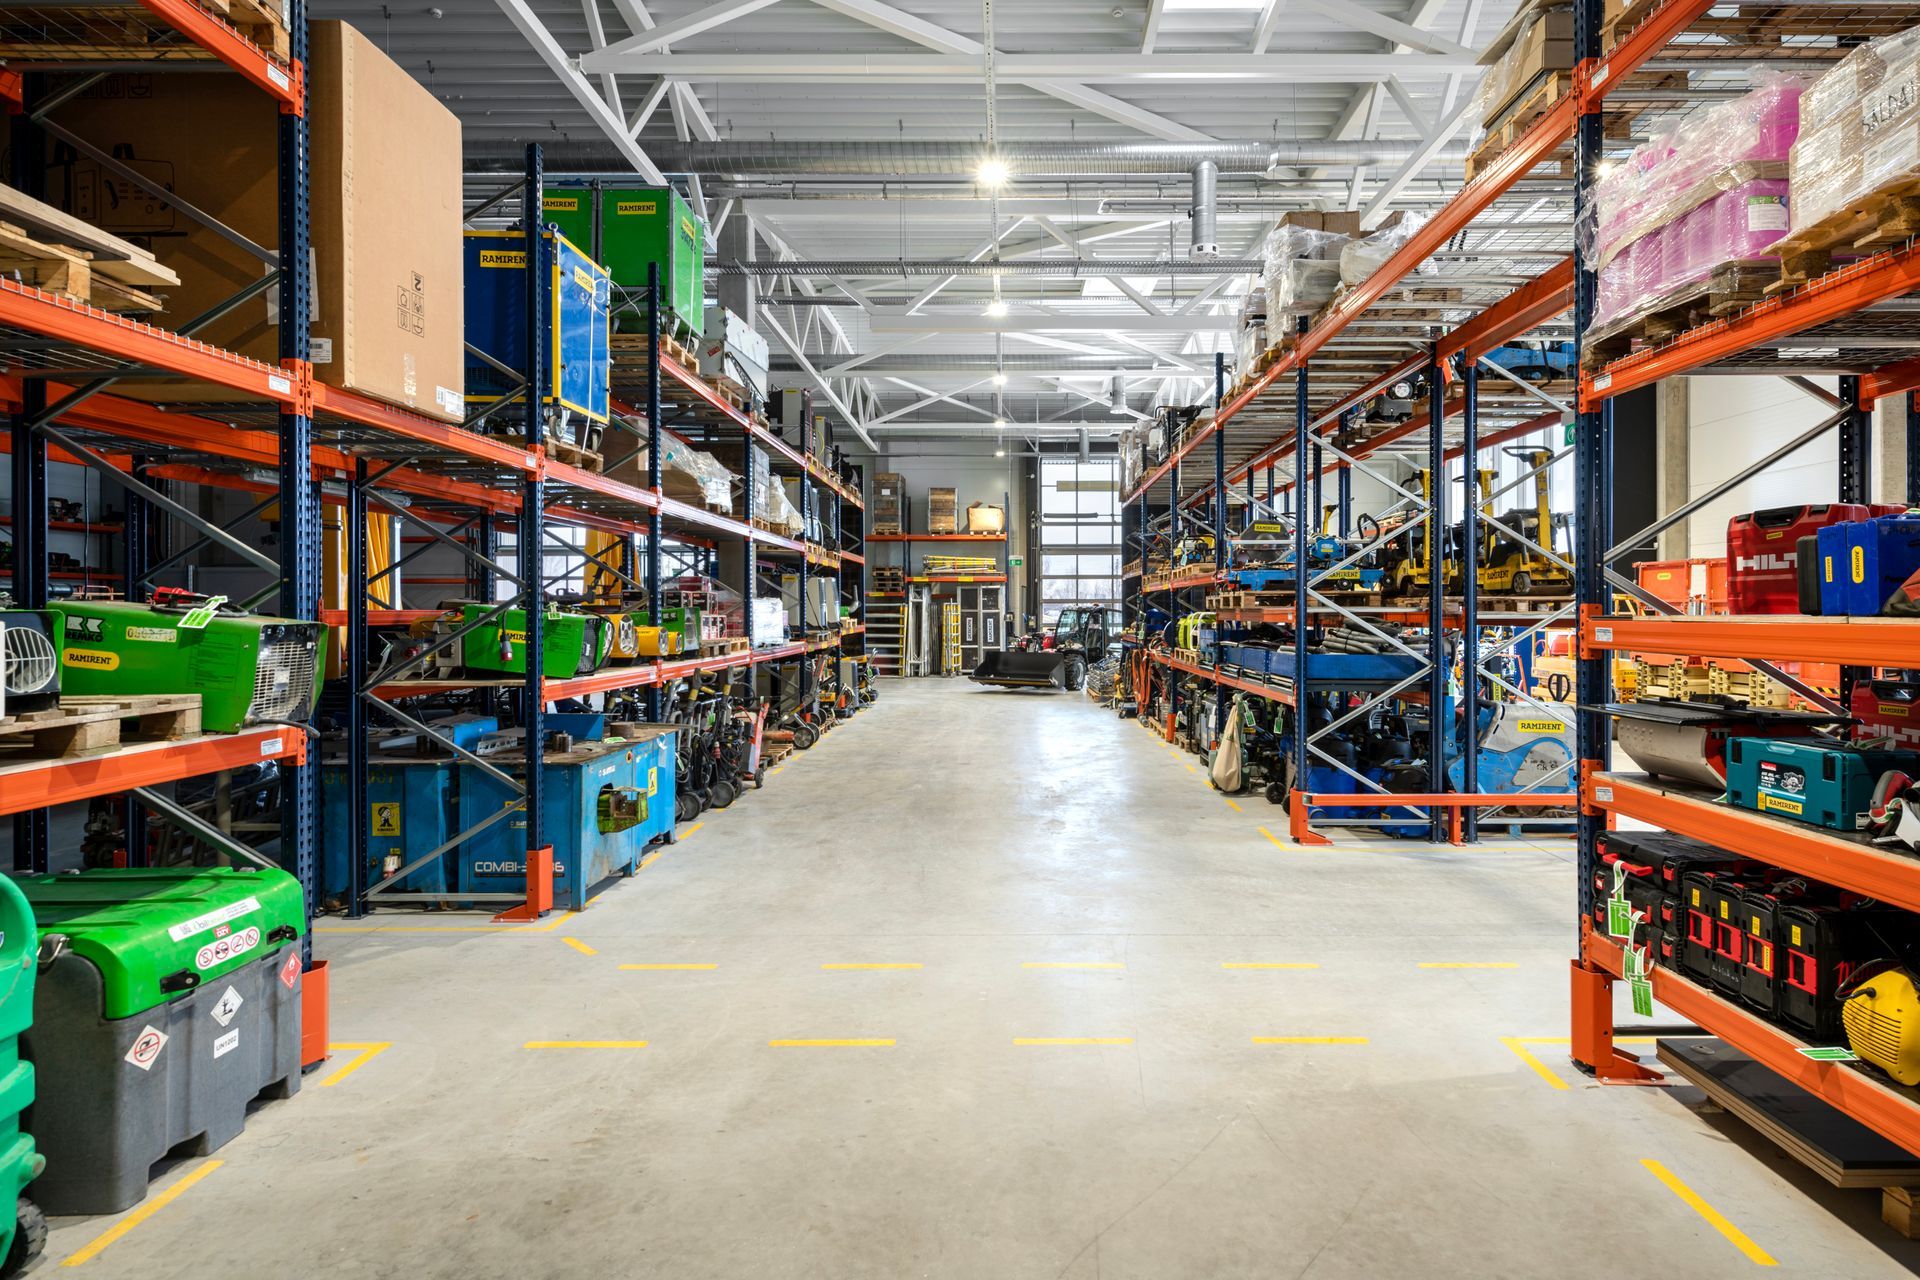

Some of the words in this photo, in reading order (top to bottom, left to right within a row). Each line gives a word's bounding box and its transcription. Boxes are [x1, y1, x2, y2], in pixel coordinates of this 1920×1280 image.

[482, 254, 526, 264] RAMIREN
[1737, 552, 1798, 572] HILT
[1487, 570, 1509, 580] RAMIRENT
[65, 631, 104, 642] REMKO
[69, 653, 112, 665] RAMIRENT
[1880, 707, 1907, 715] RAMIRENT
[1520, 722, 1562, 731] RAMIRENT
[1768, 800, 1799, 811] RAMIRENT
[475, 861, 565, 873] COMBI-6
[216, 1035, 237, 1051] UN1202
